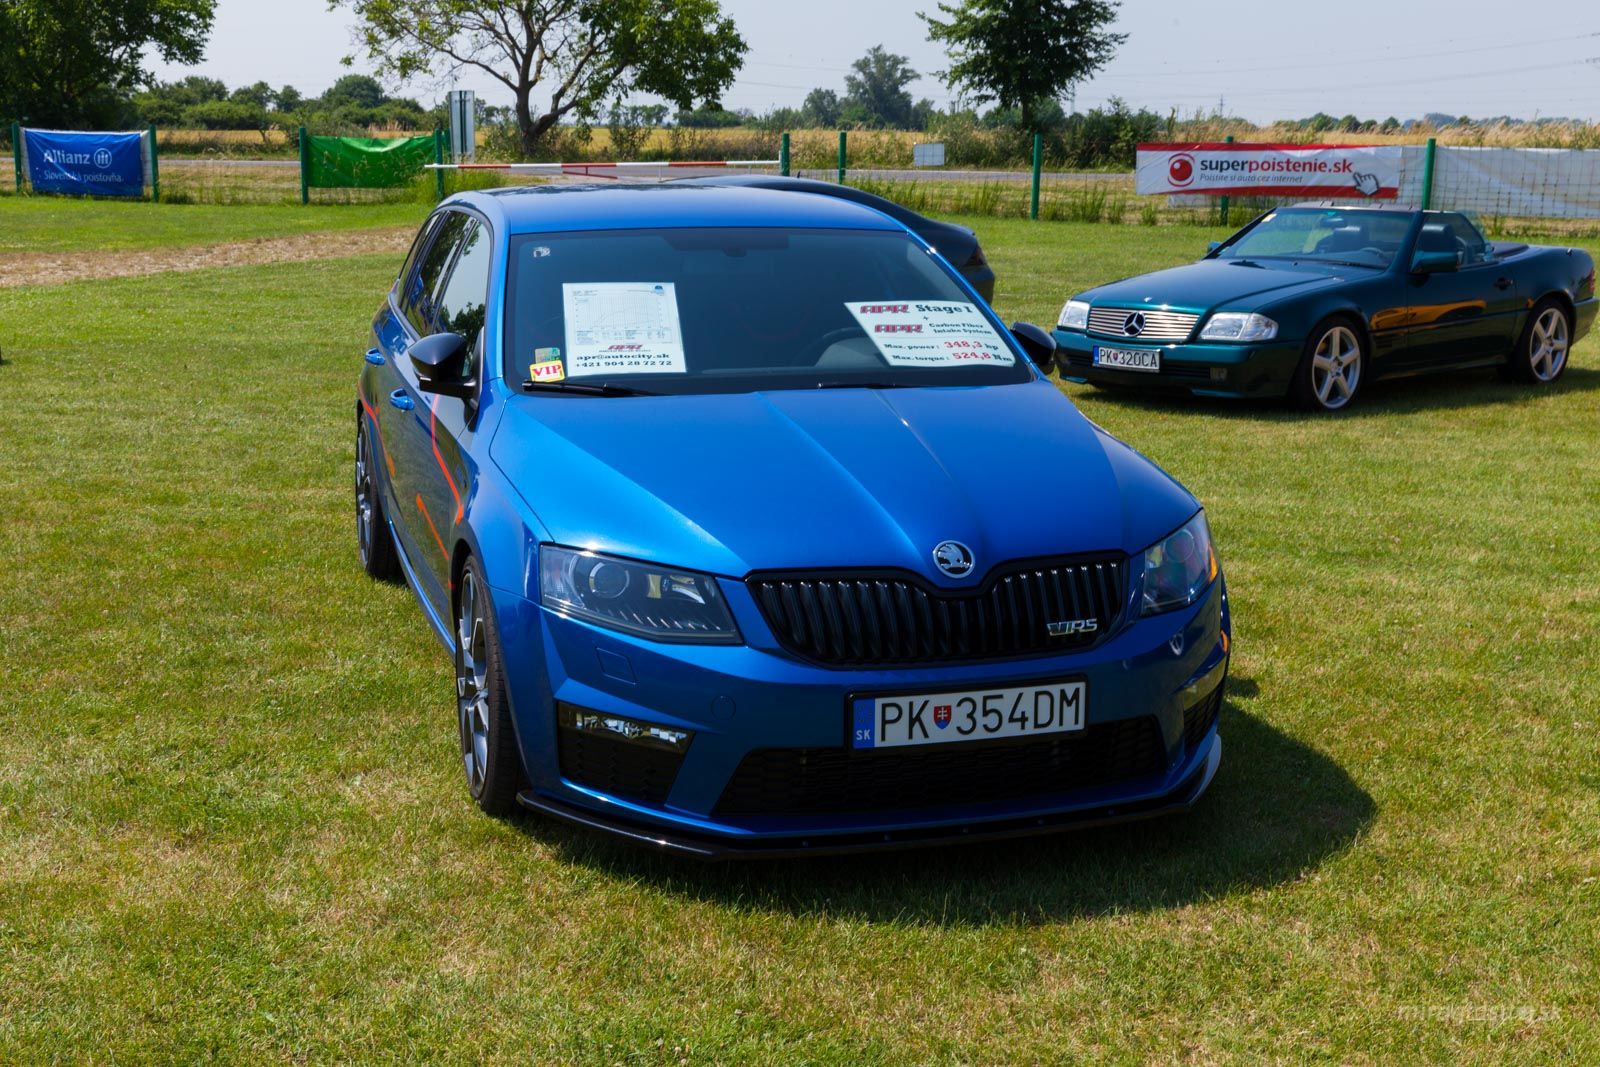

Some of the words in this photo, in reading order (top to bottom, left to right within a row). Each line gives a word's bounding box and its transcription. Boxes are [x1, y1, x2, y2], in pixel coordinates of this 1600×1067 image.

[43, 149, 90, 165] Allianz
[1200, 157, 1354, 174] superpoistenie.sk
[1271, 174, 1303, 184] internet
[915, 304, 962, 315] Stage
[944, 341, 983, 349] 348,3
[952, 352, 992, 361] 524,8
[993, 353, 1013, 362] Nm
[1100, 349, 1113, 363] PK
[1119, 351, 1157, 367] 320CA
[532, 364, 562, 376] VIP
[855, 730, 871, 741] SK
[880, 699, 930, 742] PK
[956, 687, 1080, 736] 354DM
